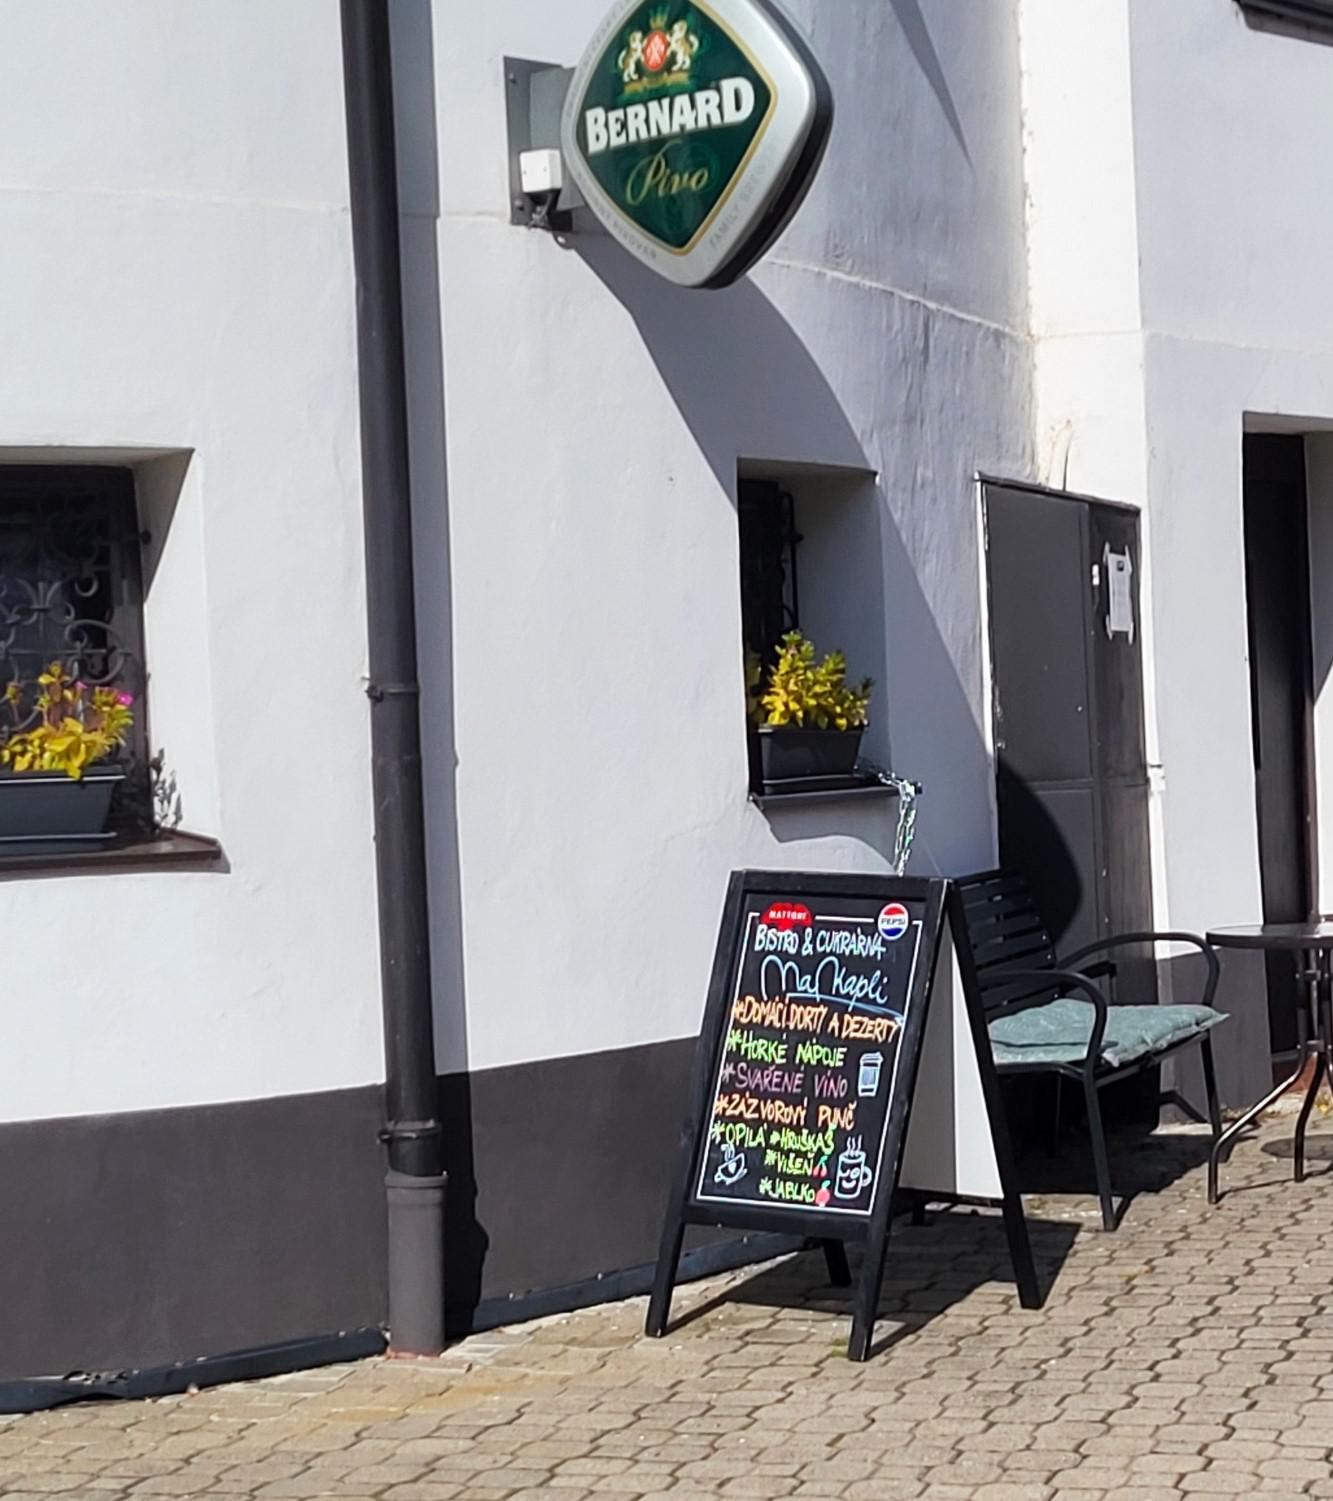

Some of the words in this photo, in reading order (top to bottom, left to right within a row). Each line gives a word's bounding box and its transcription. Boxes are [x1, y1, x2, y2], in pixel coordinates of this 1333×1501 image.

[585, 76, 755, 155] BERNARD
[626, 139, 709, 206] Pivo
[881, 917, 906, 925] PEPSI
[754, 924, 799, 955] BISTRO
[802, 927, 814, 956] &
[816, 927, 887, 960] CUKRÁRNA
[740, 995, 788, 1028] DOMÁCÍ
[789, 1003, 828, 1034] DORTY
[827, 1011, 839, 1037] A
[841, 1013, 899, 1043] DEZERTY
[740, 1030, 788, 1064] HORKÉ
[795, 1037, 847, 1067] NÁPOJE
[735, 1062, 804, 1093] SVAŘENÉ
[814, 1069, 849, 1098] VÍNO
[818, 1100, 858, 1129] PUNČ
[725, 1122, 768, 1147] OPILÁ
